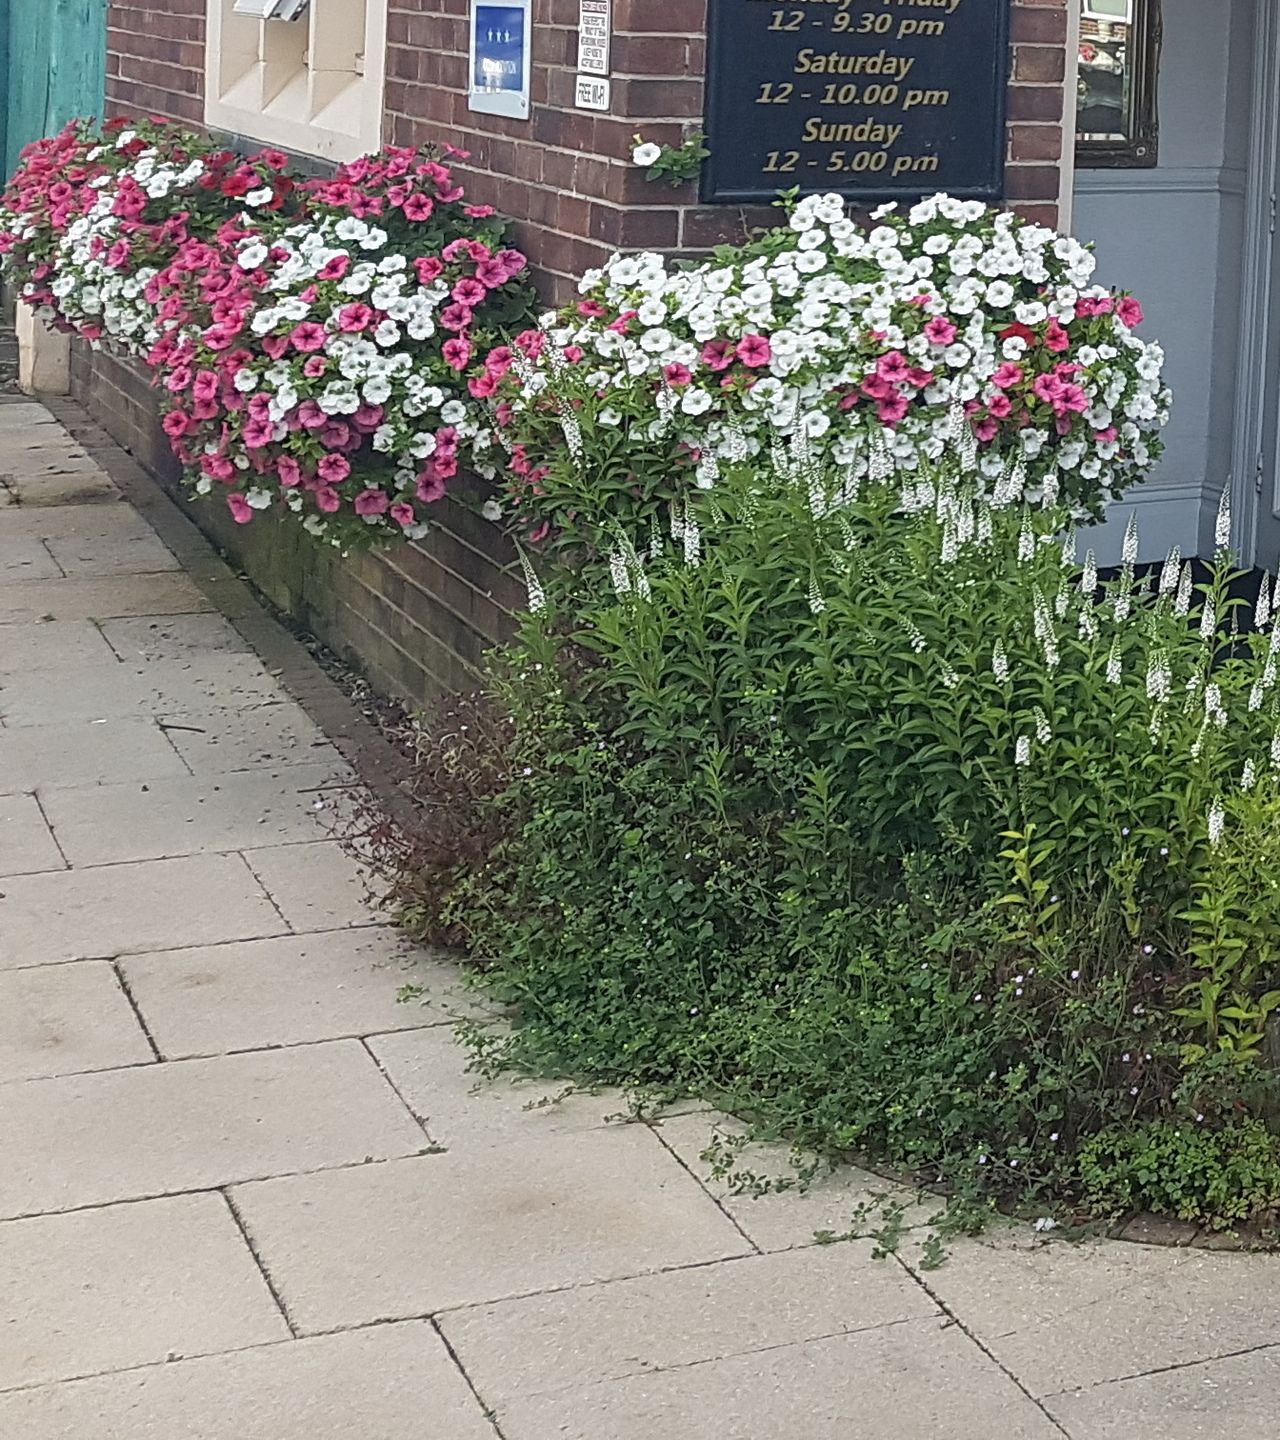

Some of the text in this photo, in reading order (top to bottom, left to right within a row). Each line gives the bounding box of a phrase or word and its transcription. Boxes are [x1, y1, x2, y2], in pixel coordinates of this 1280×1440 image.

[767, 10, 805, 32] 12
[831, 12, 893, 34] 9.30
[896, 18, 945, 40] pm
[794, 48, 916, 82] Saturday
[577, 82, 592, 104] FREE
[755, 82, 794, 105] 12
[819, 84, 899, 105] 10.00
[902, 89, 950, 111] pm
[801, 116, 904, 149] Sunday
[761, 151, 800, 172] 12
[825, 150, 888, 172] 5.00
[891, 155, 939, 177] pm
